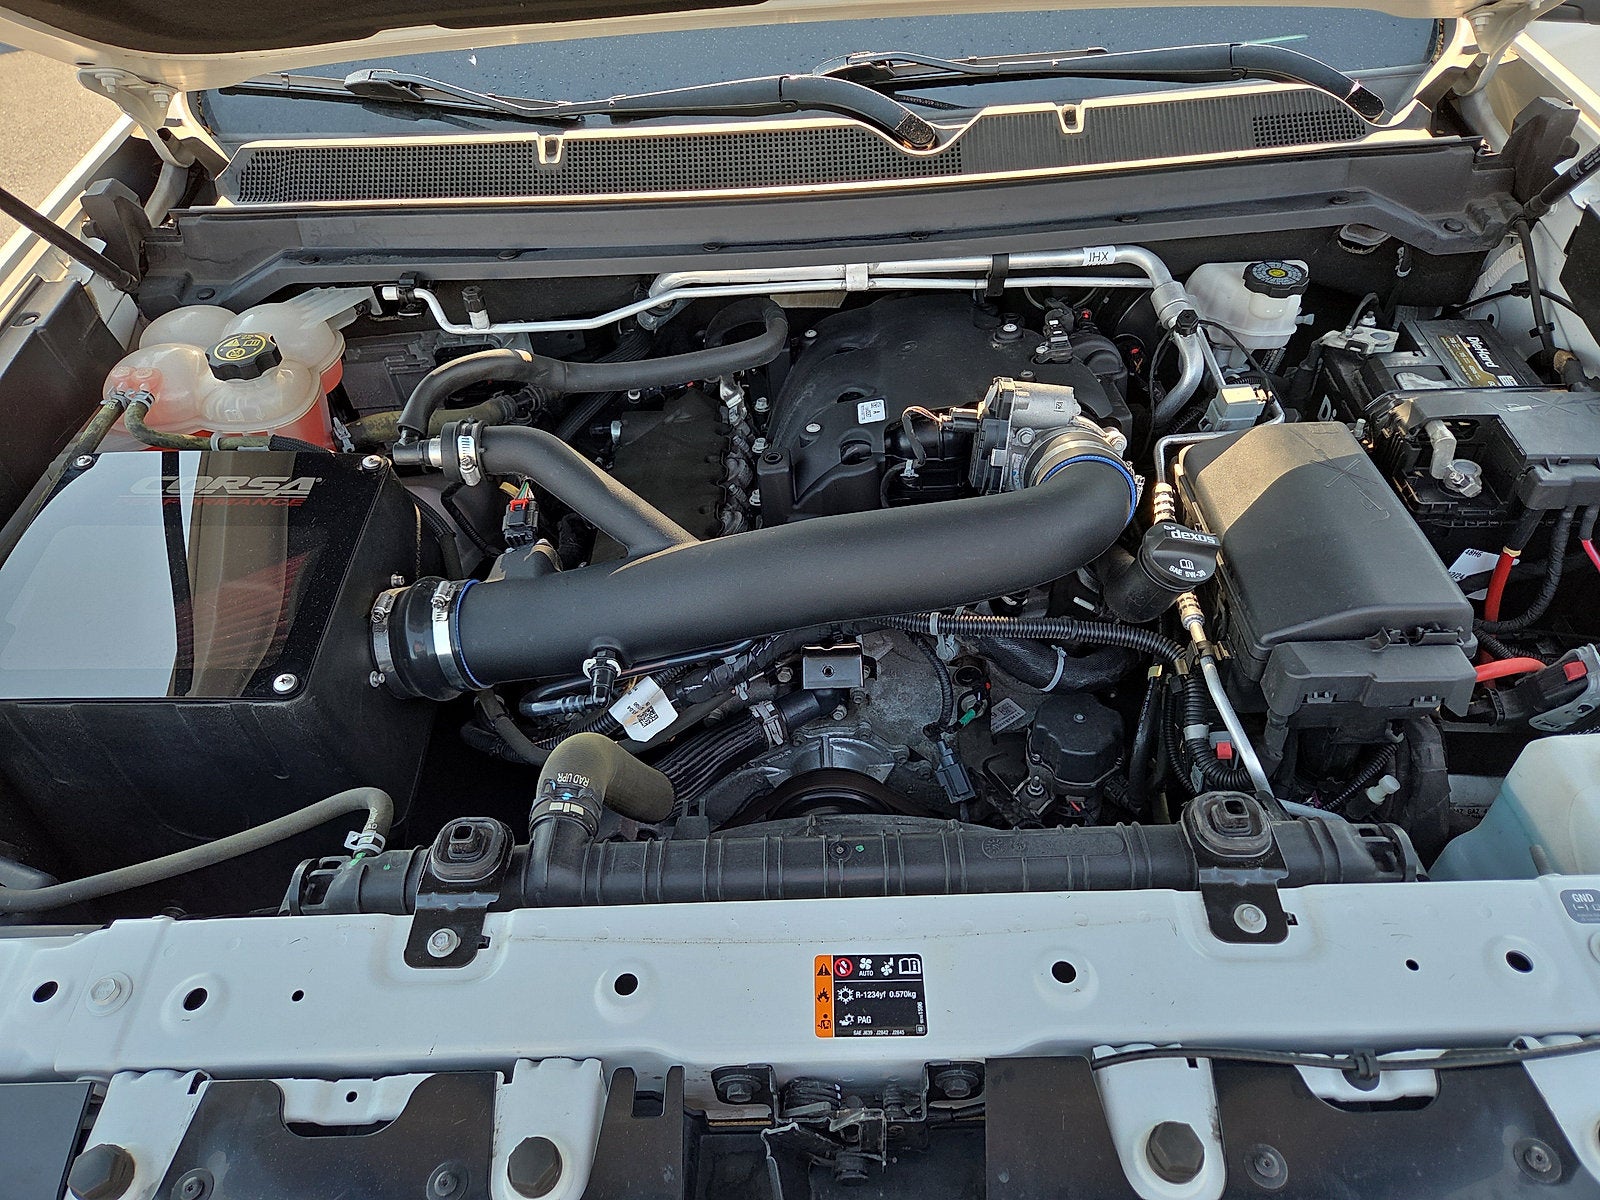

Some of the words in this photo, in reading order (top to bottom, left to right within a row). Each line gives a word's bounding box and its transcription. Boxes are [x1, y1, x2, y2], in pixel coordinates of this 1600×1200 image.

[1466, 336, 1500, 368] DieHard
[130, 476, 316, 496] CORSA
[1170, 529, 1216, 544] dexos
[1168, 565, 1183, 576] SAE
[556, 772, 573, 783] UPR
[573, 774, 590, 788] RAD
[1571, 893, 1595, 903] GND
[855, 991, 886, 999] R-1234yf
[888, 990, 917, 999] 0.570kg
[857, 1016, 872, 1024] PAG
